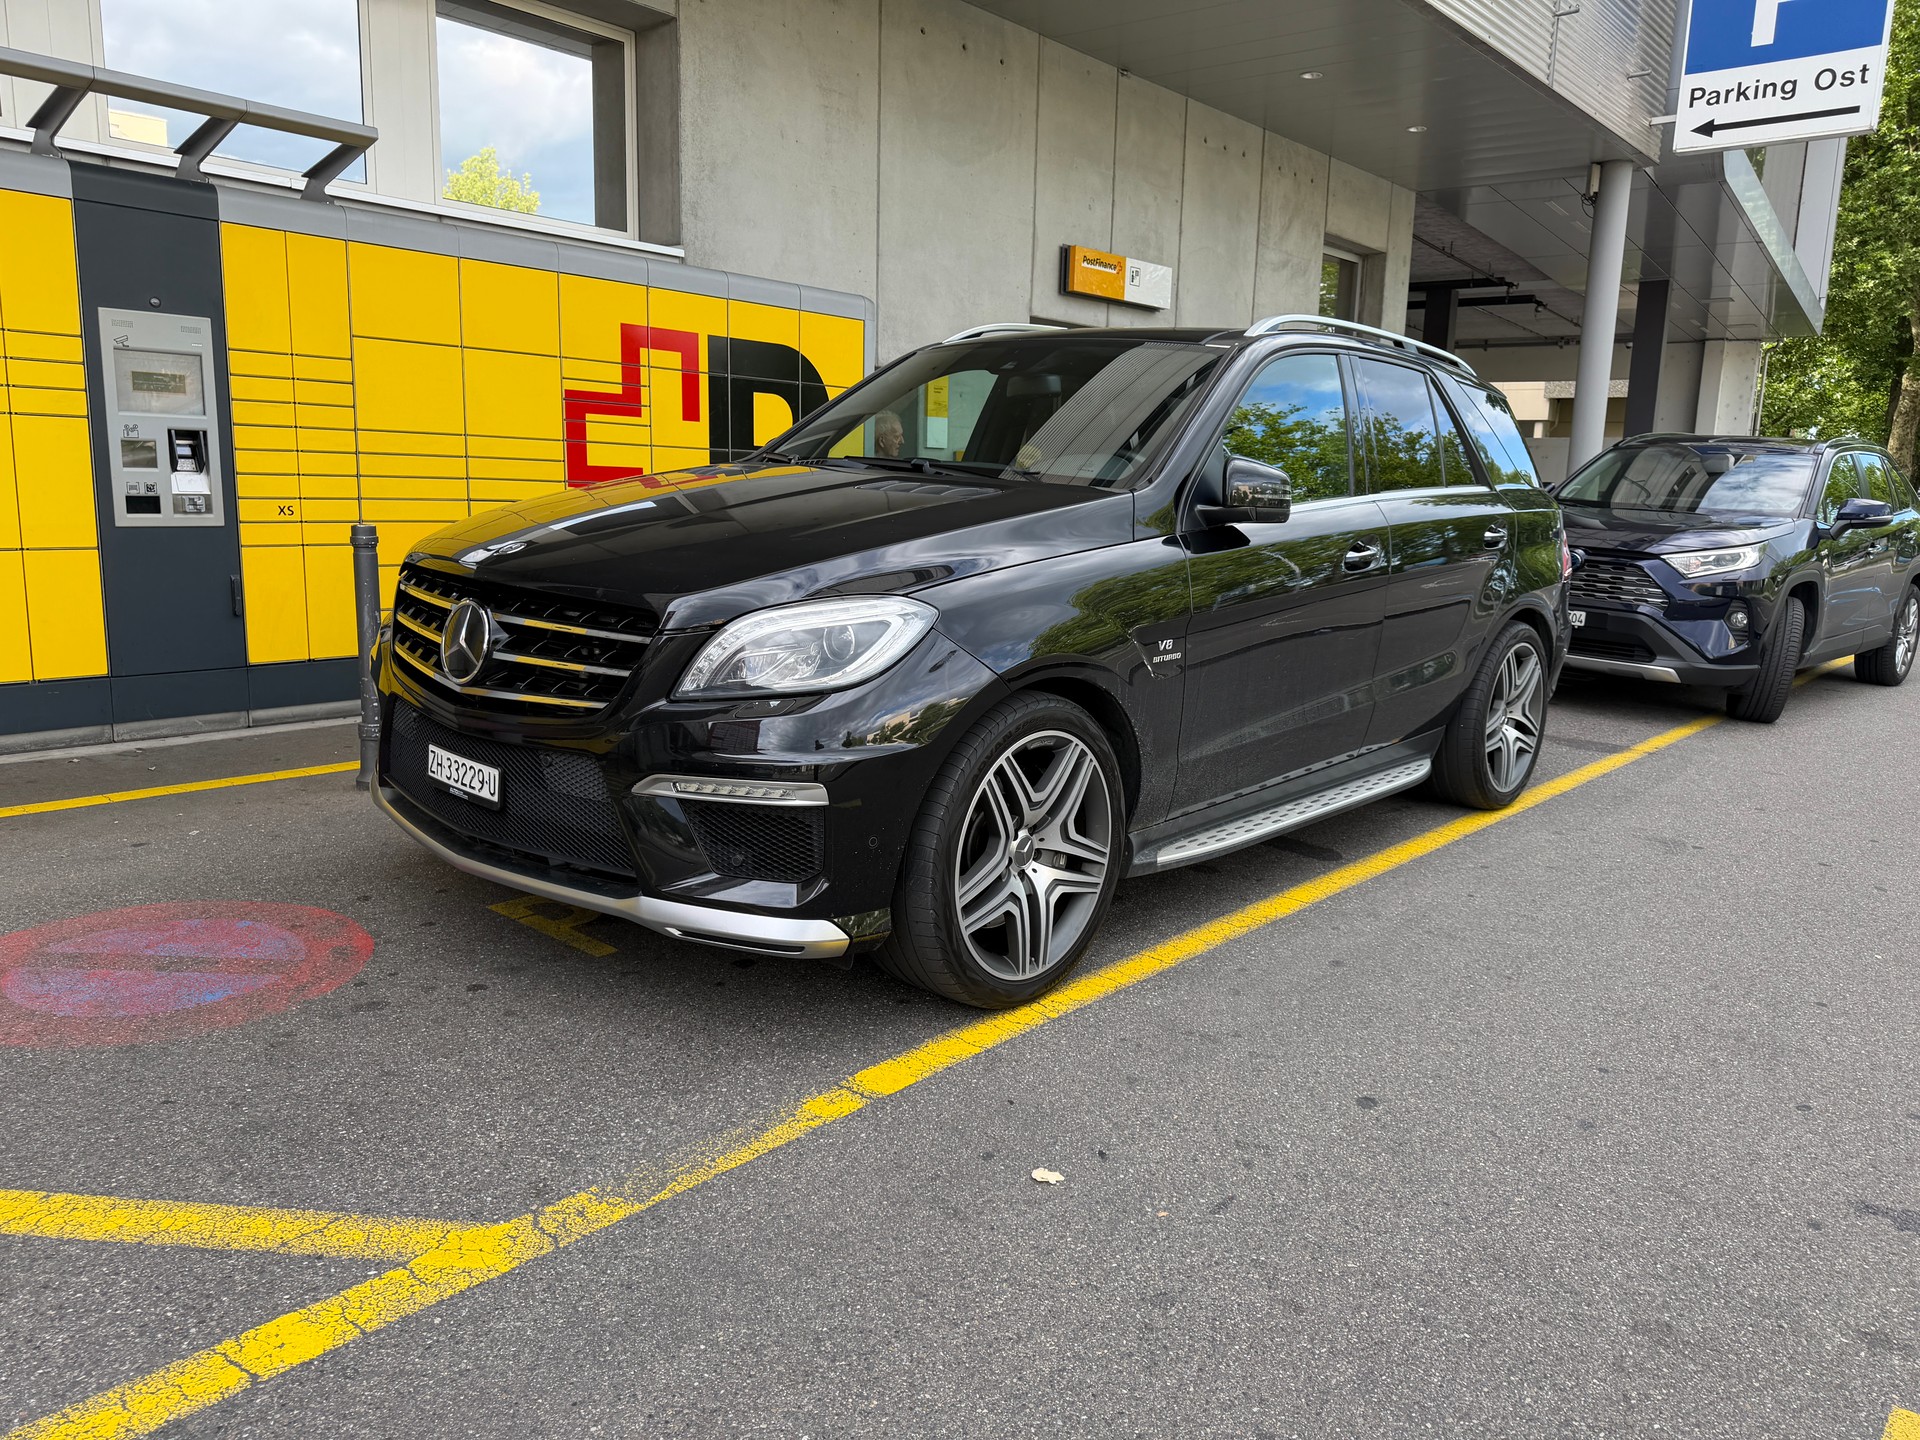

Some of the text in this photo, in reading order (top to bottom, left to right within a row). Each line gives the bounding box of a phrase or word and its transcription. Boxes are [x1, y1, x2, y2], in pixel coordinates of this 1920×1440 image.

[1688, 63, 1870, 109] Parking Ost
[1082, 255, 1118, 272] PostFinance
[277, 504, 295, 517] XS
[1568, 611, 1584, 625] 04
[1158, 639, 1174, 652] V8
[1152, 652, 1182, 664] BITURBO
